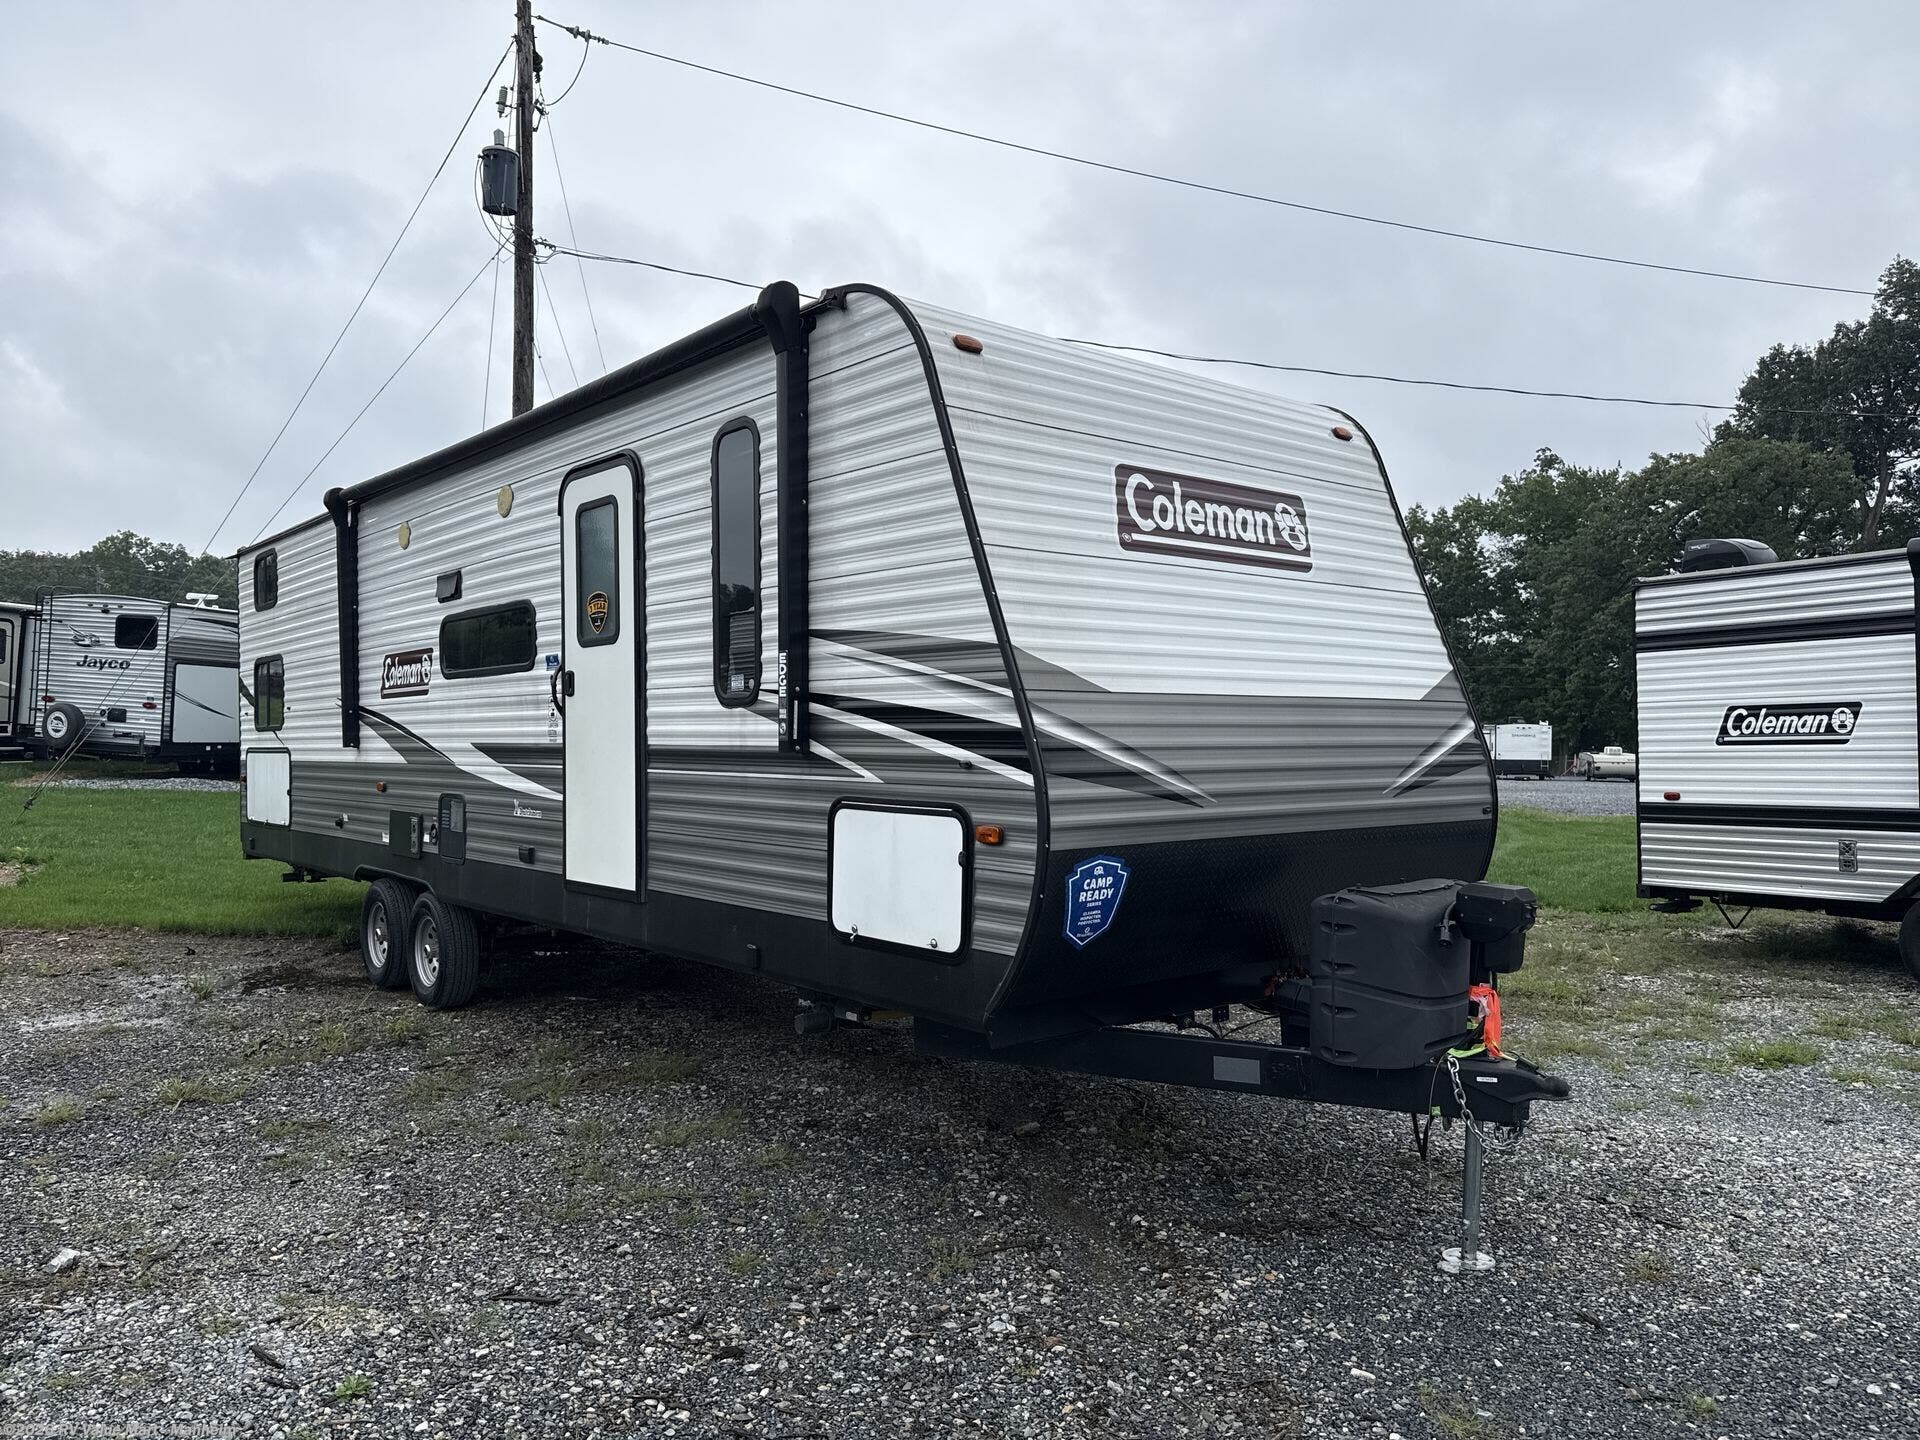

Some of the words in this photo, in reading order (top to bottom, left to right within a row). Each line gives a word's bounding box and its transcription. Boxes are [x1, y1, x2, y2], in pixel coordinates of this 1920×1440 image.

[1125, 473, 1276, 545] Coleman
[76, 655, 131, 671] Jayco
[384, 656, 421, 688] Coleman
[779, 652, 787, 697] EDGE
[1727, 708, 1829, 737] Coleman
[1079, 888, 1114, 902] READY
[1084, 877, 1113, 890] CAMP
